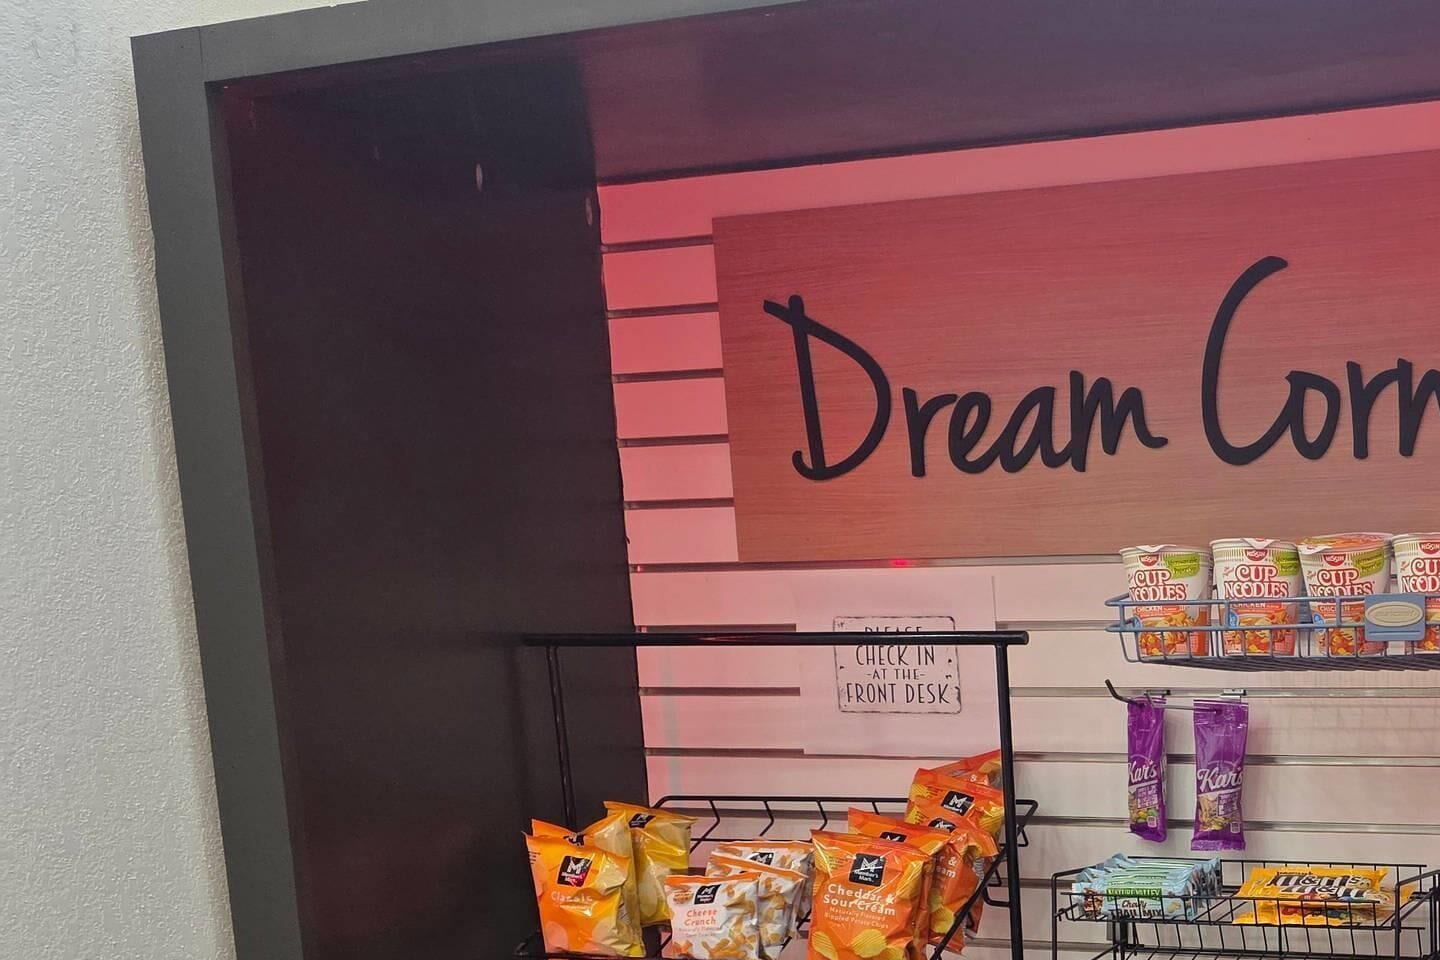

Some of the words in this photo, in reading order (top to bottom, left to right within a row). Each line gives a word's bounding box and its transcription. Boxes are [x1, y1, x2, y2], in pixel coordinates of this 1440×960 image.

[764, 294, 1168, 481] Dream
[1133, 569, 1172, 587] CUP
[1235, 564, 1279, 582] CUP
[1317, 568, 1360, 587] CUP
[1129, 584, 1187, 600] NOODLES
[1224, 581, 1289, 599] NOODLES
[1309, 583, 1373, 597] NOODLES
[855, 644, 909, 666] CHECK
[917, 645, 935, 666] IN
[846, 682, 897, 703] FRONT
[905, 683, 950, 704] DESK
[827, 883, 882, 902] Cheddar
[886, 893, 896, 905] &
[686, 909, 718, 918] Cheese
[823, 894, 853, 908] Sour
[856, 900, 897, 917] Cream
[684, 918, 716, 927] Crunch
